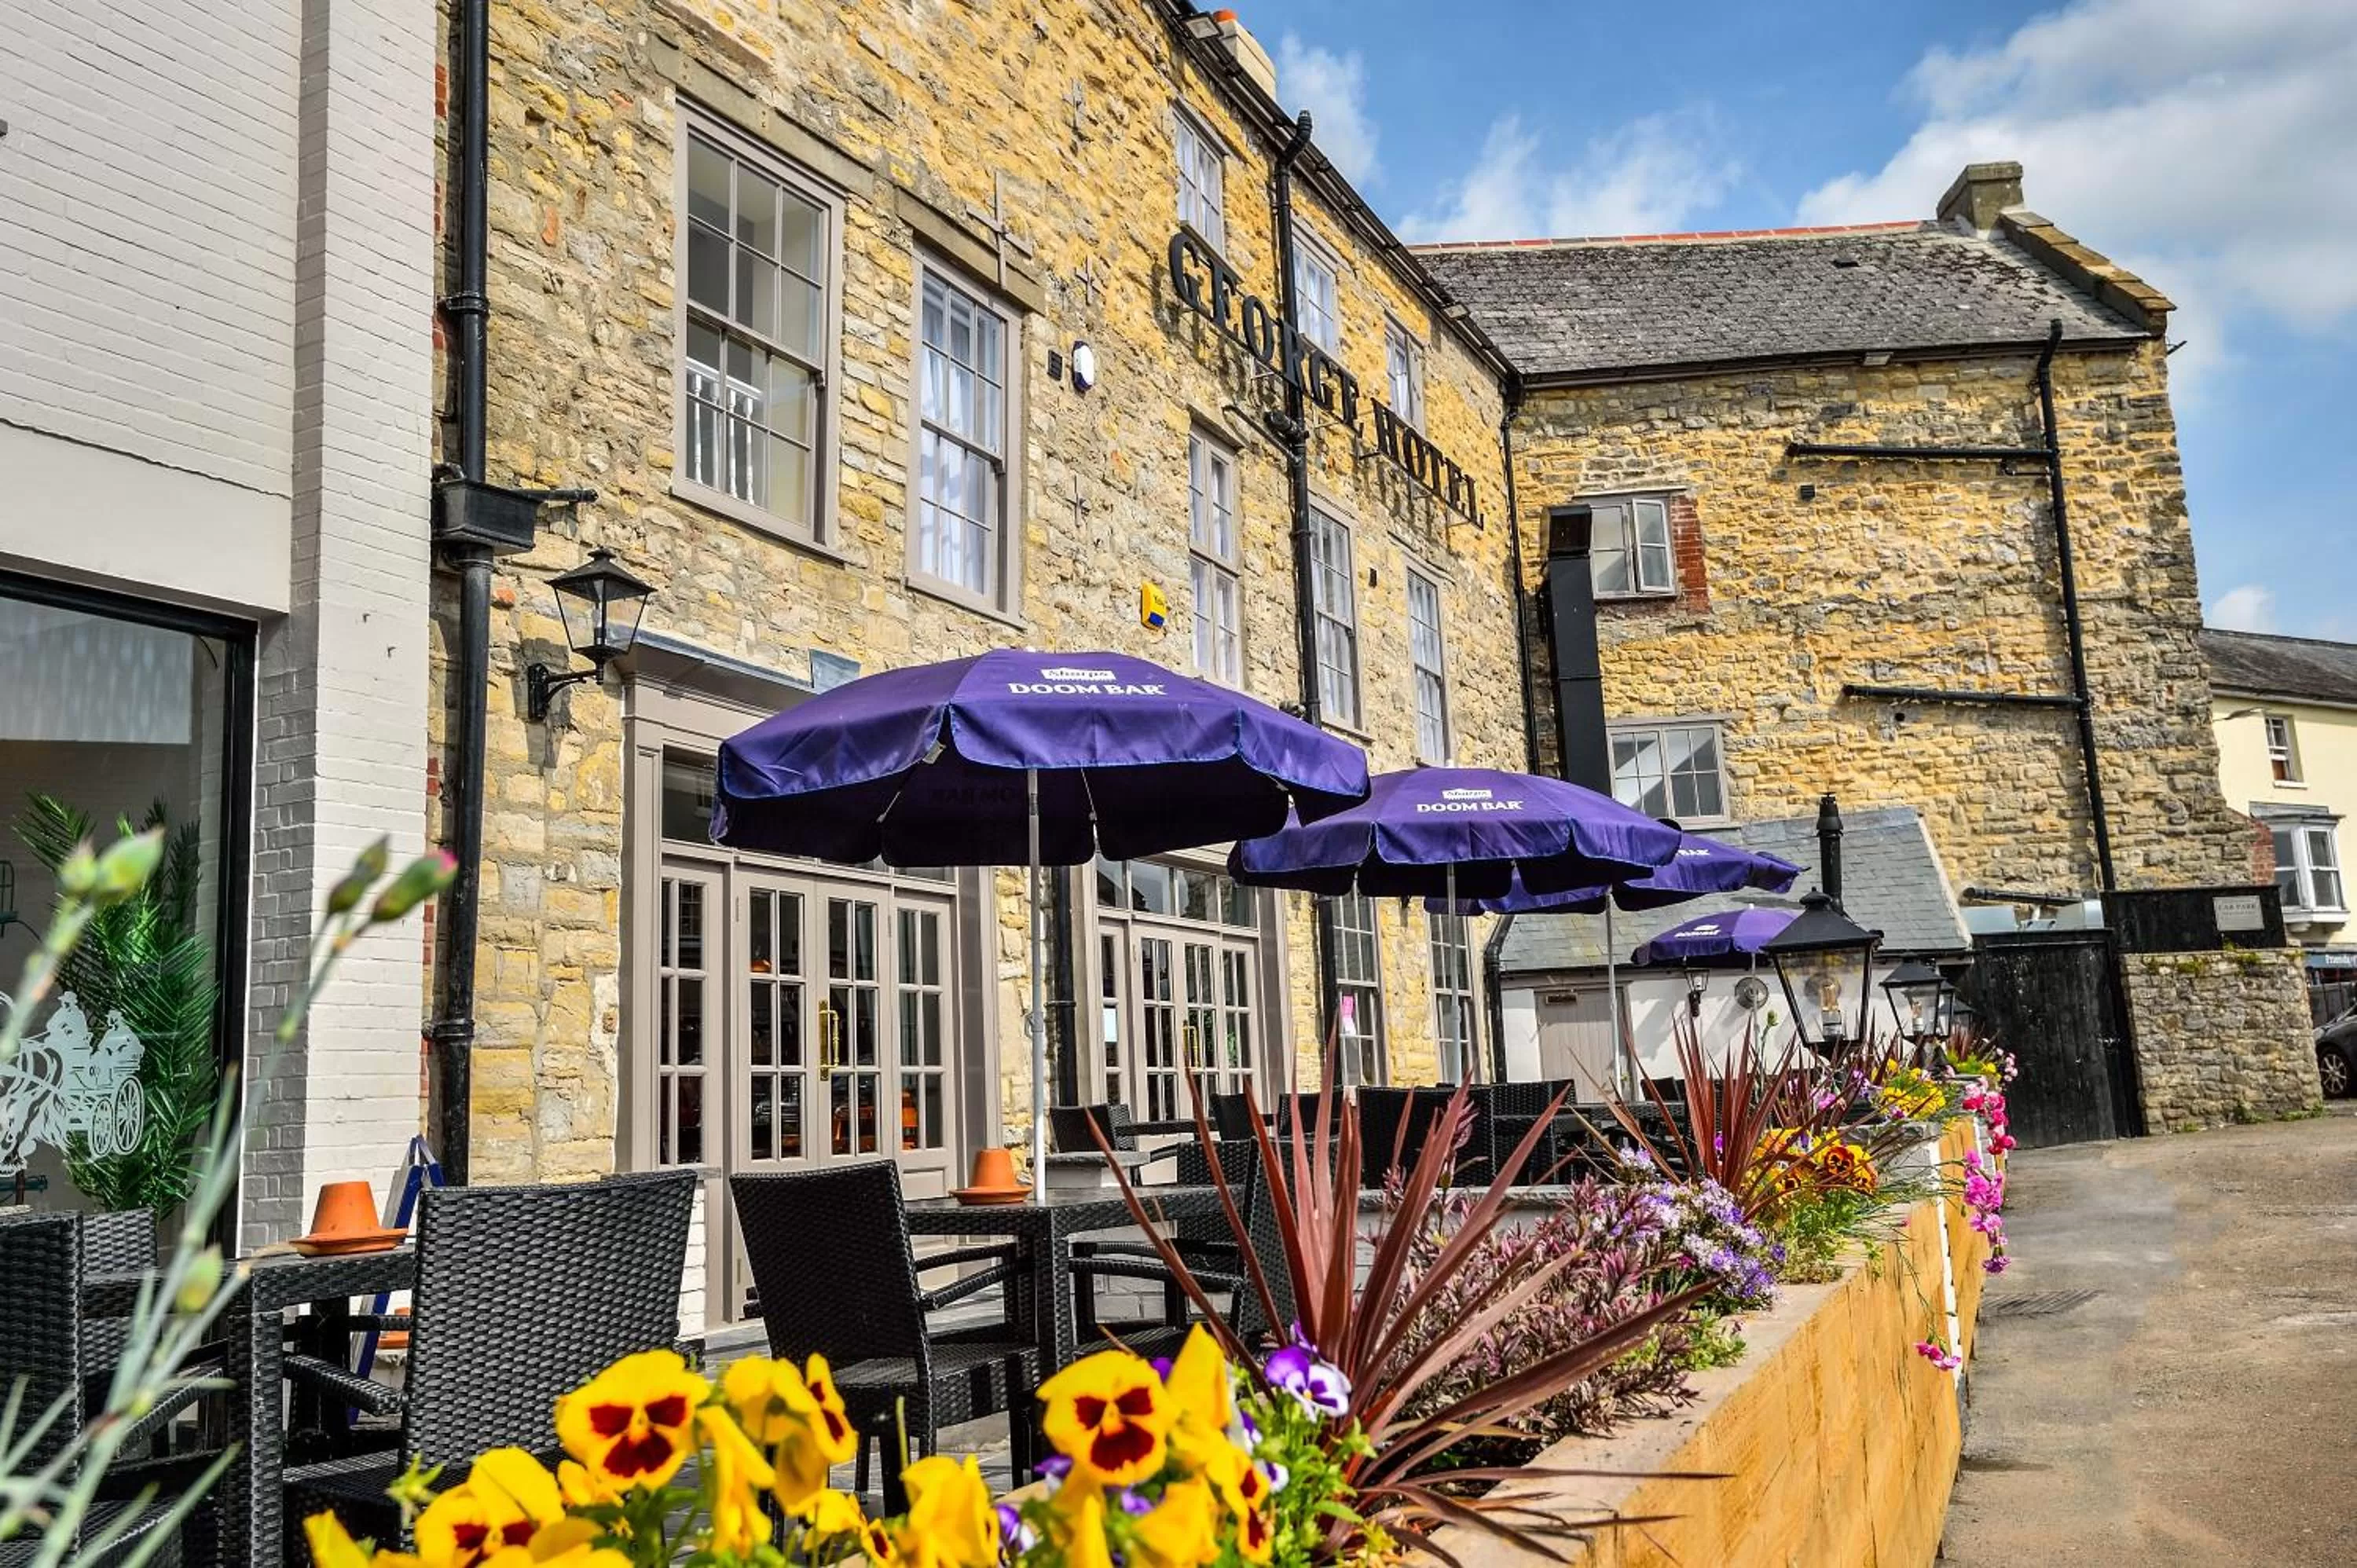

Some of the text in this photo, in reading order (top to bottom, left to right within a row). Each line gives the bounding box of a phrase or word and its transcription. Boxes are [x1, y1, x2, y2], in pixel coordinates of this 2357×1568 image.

[1169, 233, 1484, 531] GEORGE HOTEL
[1008, 683, 1167, 695] DOOM BAR
[1417, 800, 1523, 812] DOOM BAR
